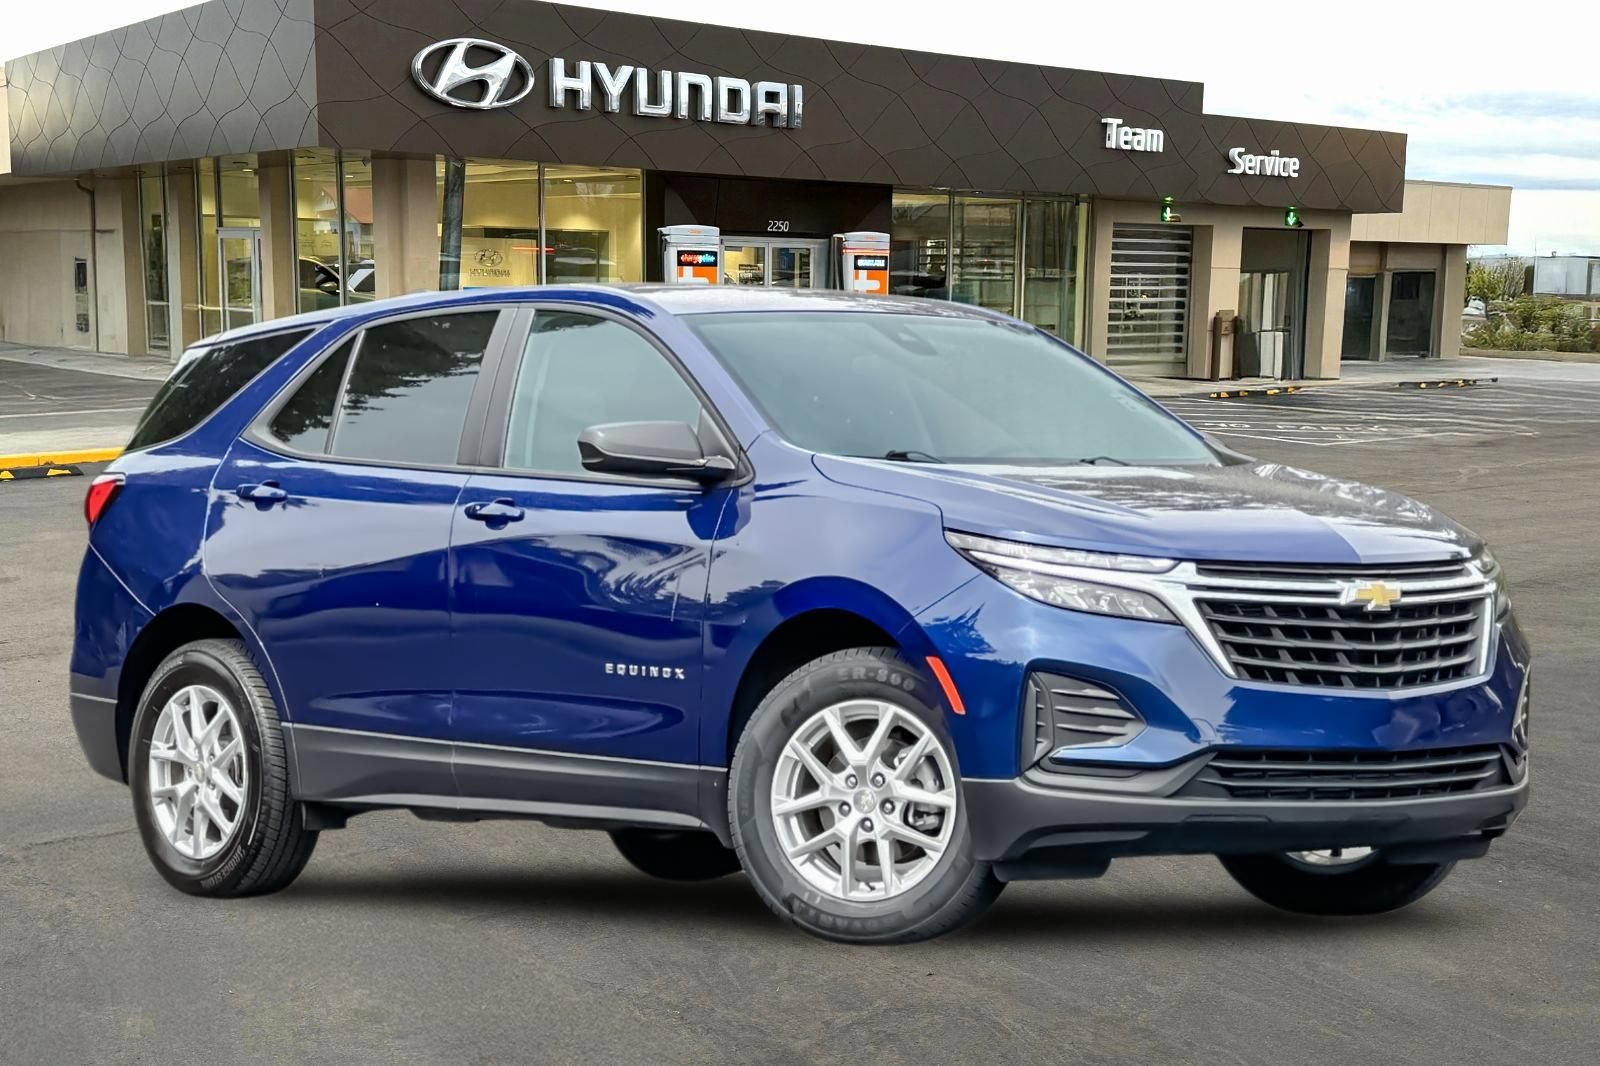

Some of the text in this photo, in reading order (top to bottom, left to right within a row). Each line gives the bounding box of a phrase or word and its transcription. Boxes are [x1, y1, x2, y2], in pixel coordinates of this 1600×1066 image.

[549, 57, 803, 129] HYUNDAI
[1101, 117, 1164, 152] Team
[1227, 147, 1300, 177] Service
[767, 220, 790, 232] 2250
[605, 663, 685, 680] EQUINOX
